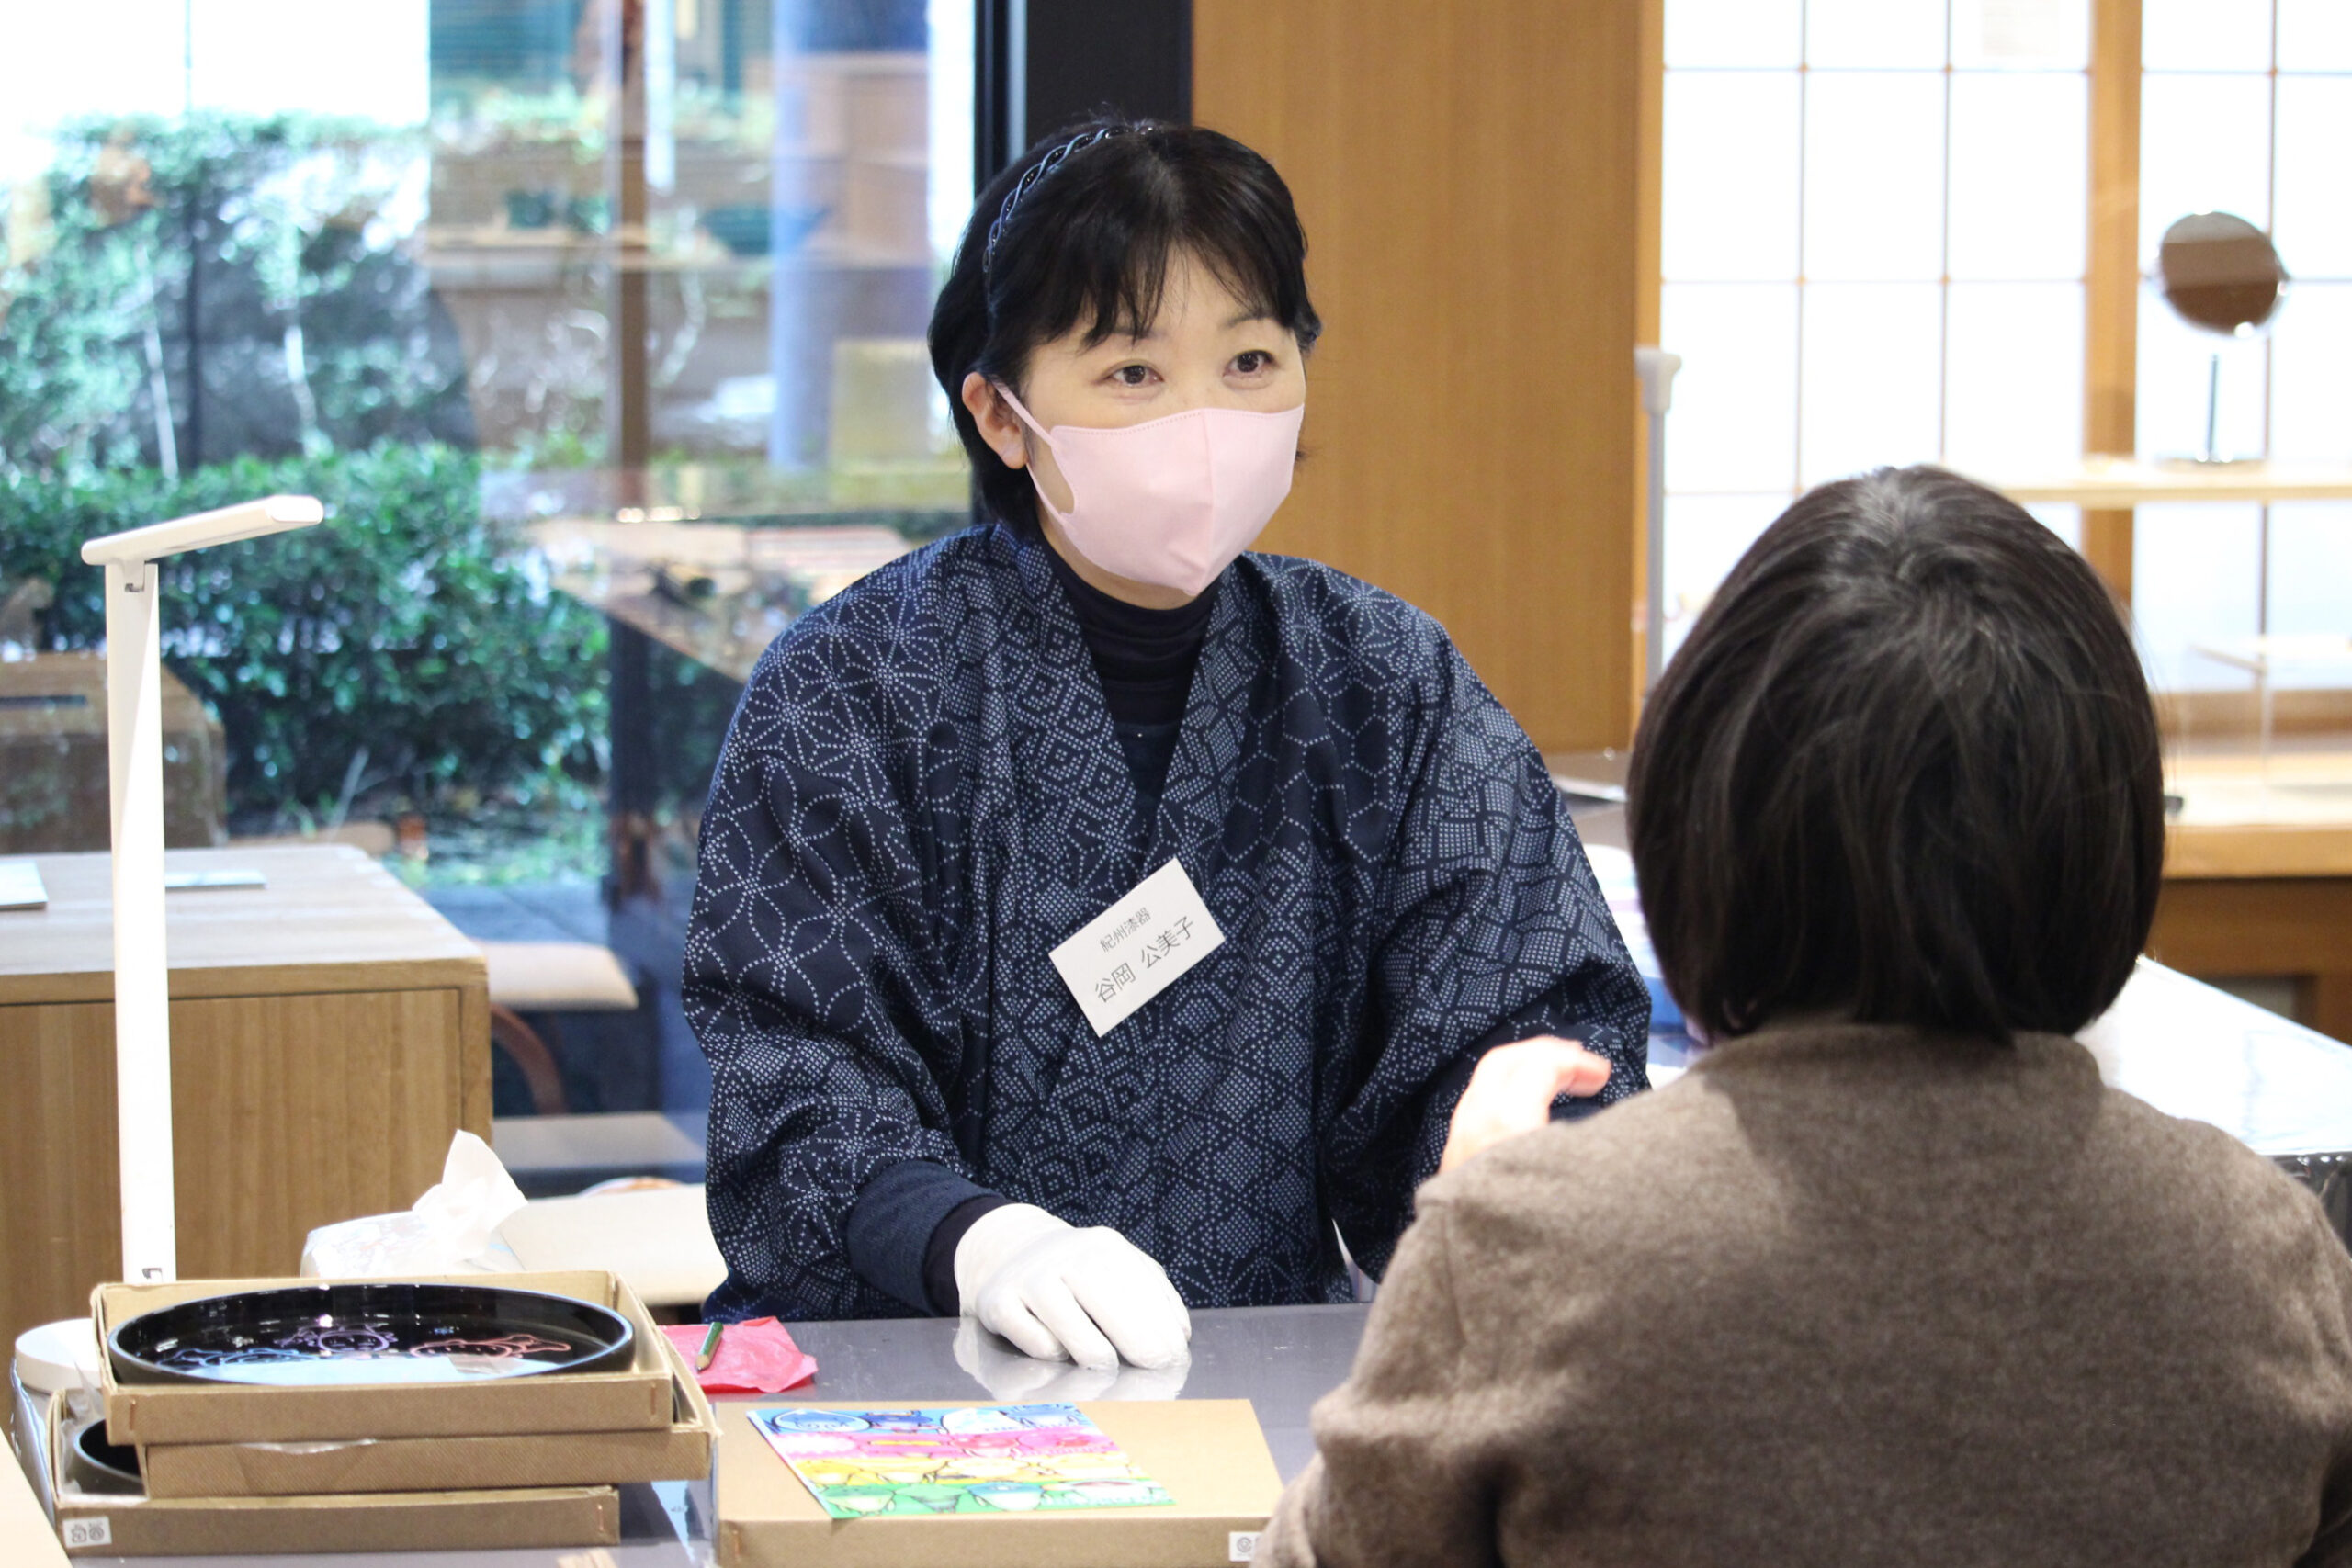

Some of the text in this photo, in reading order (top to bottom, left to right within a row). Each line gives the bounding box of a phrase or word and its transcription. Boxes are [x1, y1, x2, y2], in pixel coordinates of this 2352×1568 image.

[1095, 916, 1193, 1003] 谷岡 公美子
[1100, 907, 1151, 953] 紀州漆器
